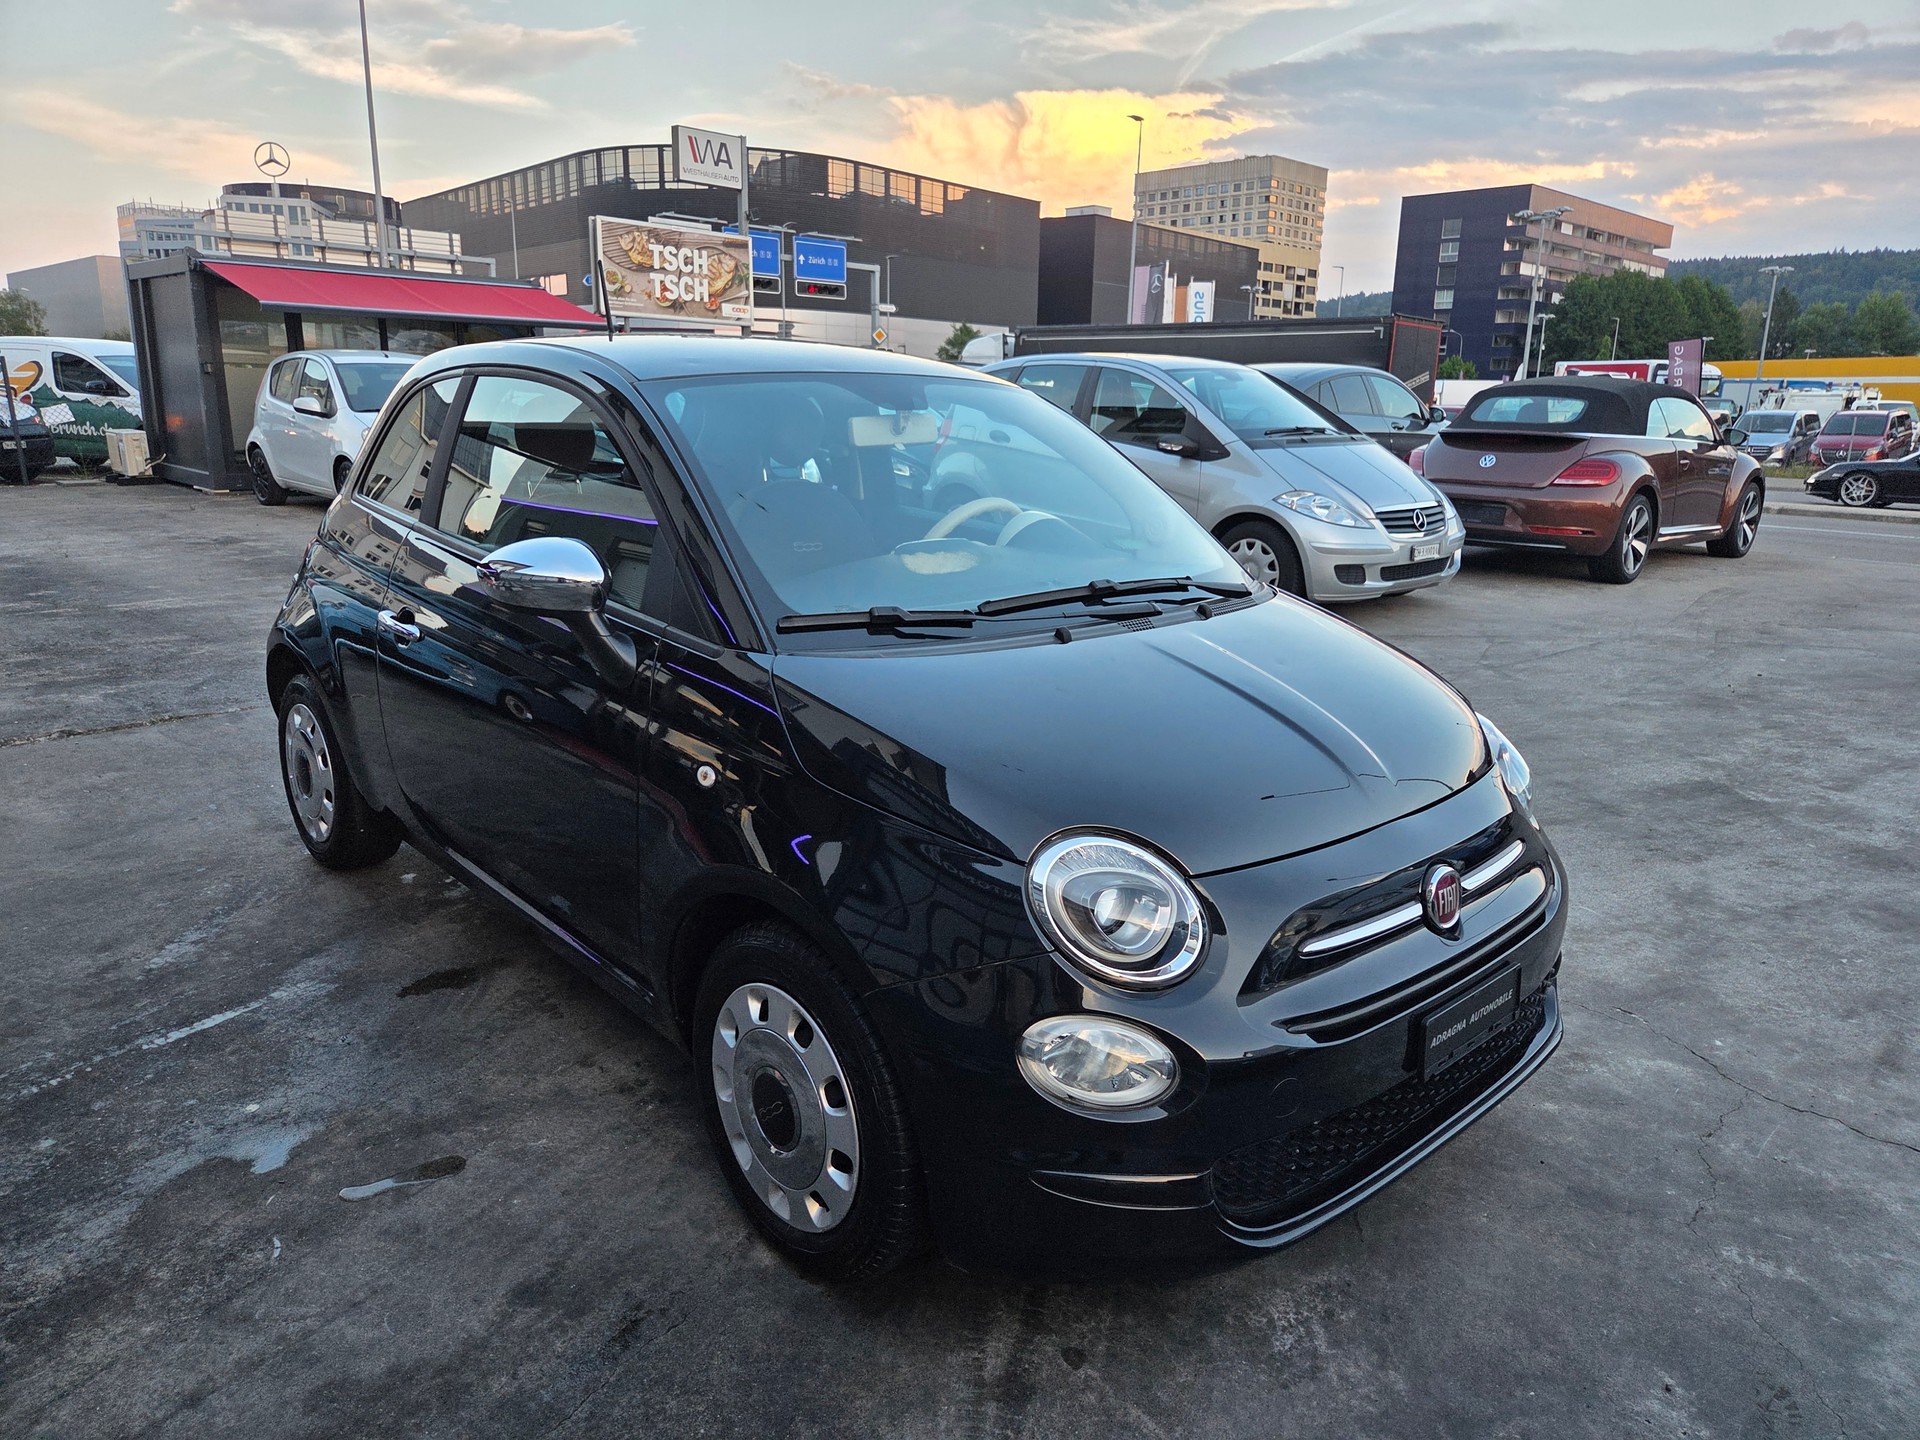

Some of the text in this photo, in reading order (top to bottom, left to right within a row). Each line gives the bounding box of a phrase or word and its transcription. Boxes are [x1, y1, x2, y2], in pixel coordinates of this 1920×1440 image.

[648, 243, 708, 274] TSCH
[650, 272, 709, 302] TSCH
[1438, 882, 1457, 917] FIAT
[1430, 988, 1514, 1049] ADRAGNA AUTOMOBILE
